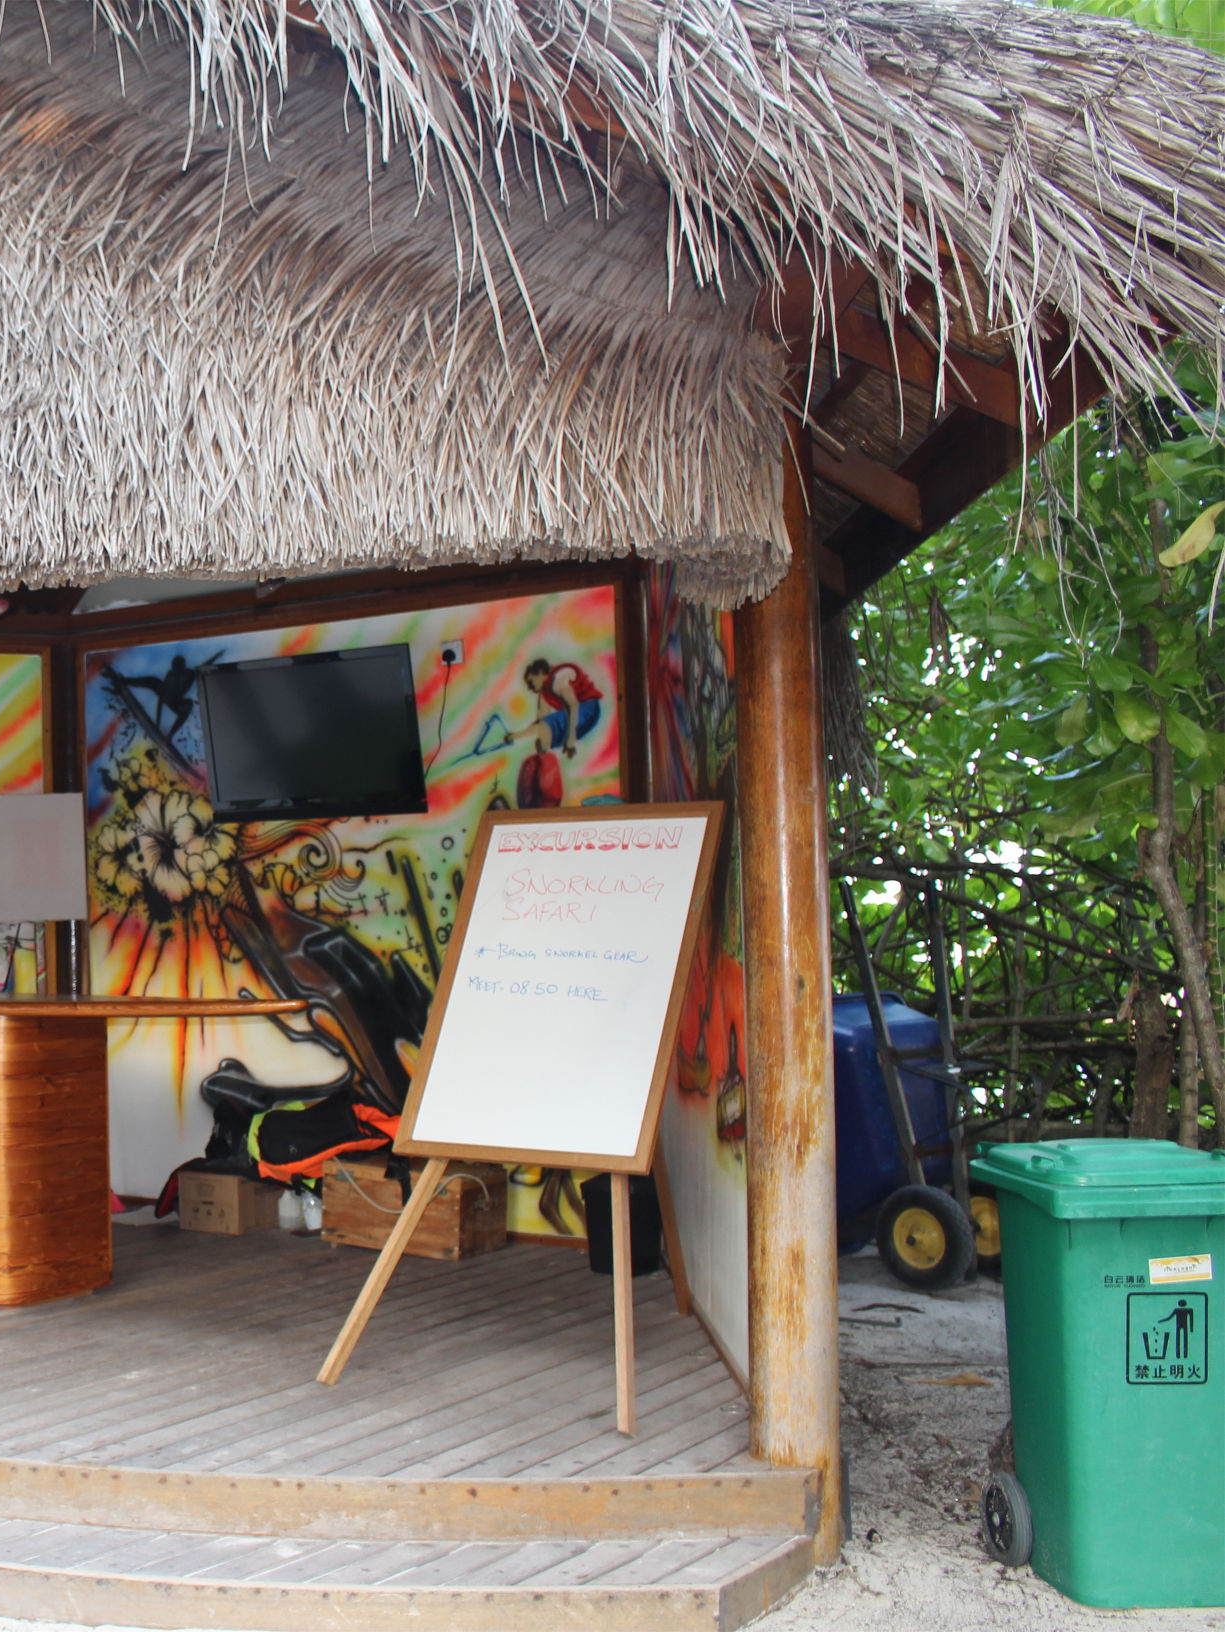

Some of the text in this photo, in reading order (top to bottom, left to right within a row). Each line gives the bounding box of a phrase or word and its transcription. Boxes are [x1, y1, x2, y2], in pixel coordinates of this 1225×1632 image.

[497, 825, 683, 853] EXCURSION
[505, 867, 665, 903] SNORKLING
[501, 897, 597, 924] SAFARI
[1135, 1364, 1201, 1380] 禁止明火
